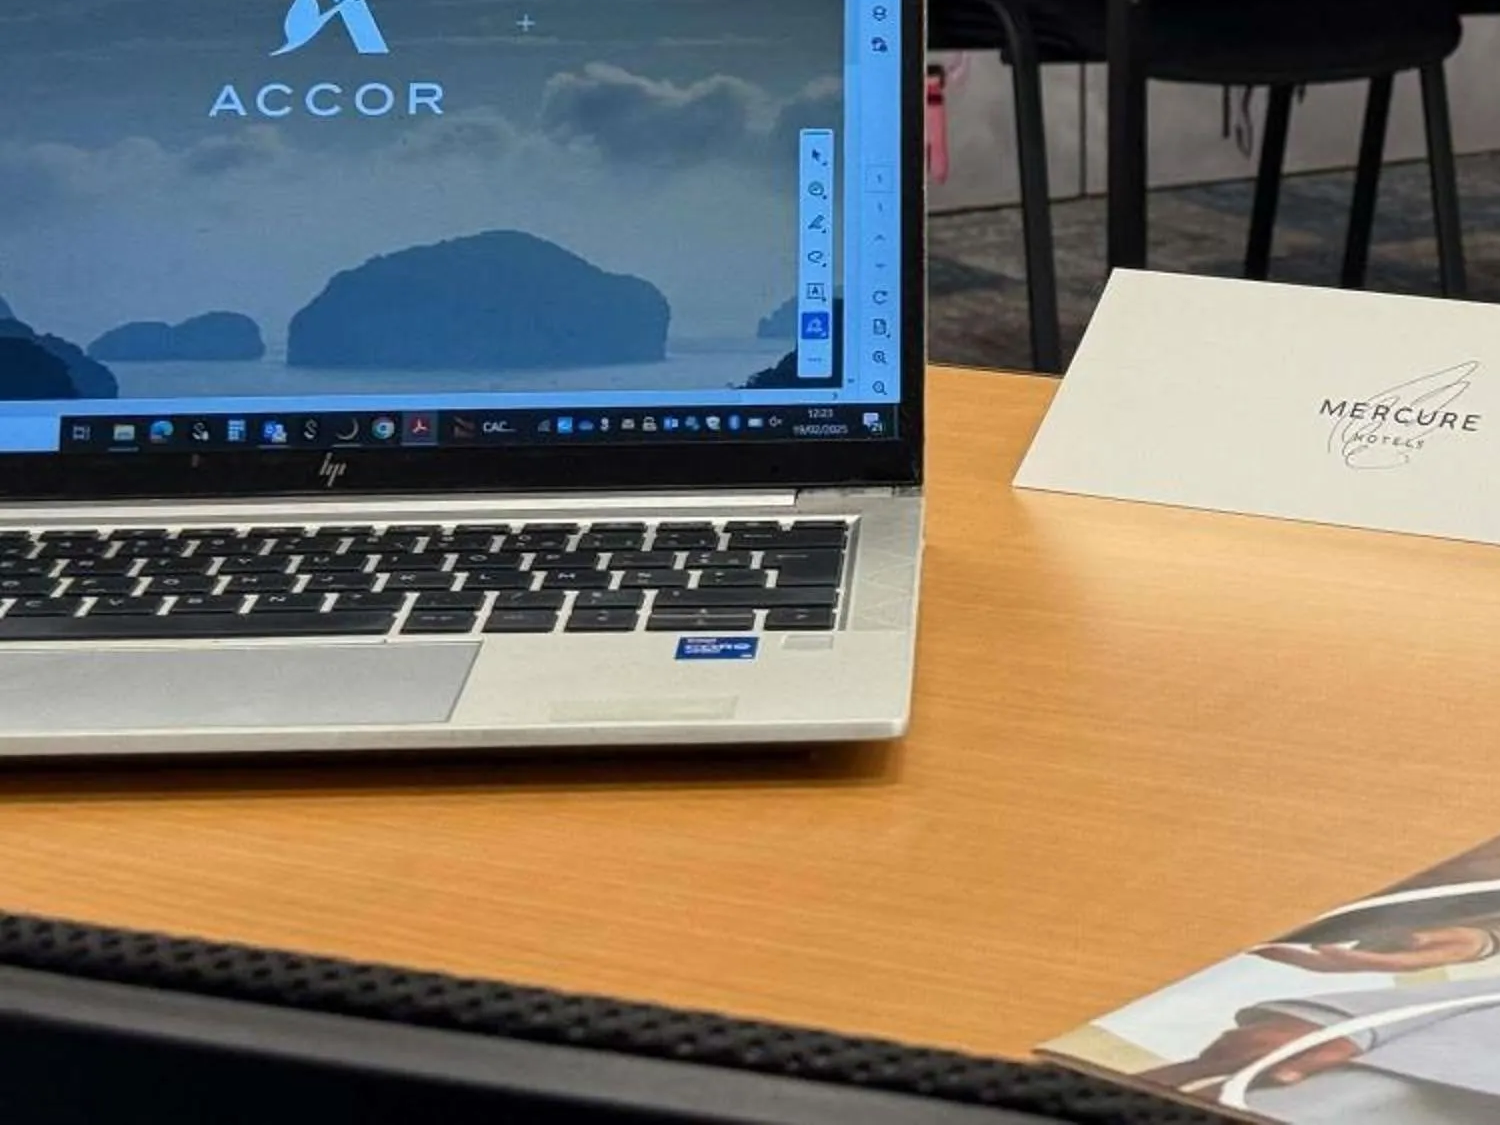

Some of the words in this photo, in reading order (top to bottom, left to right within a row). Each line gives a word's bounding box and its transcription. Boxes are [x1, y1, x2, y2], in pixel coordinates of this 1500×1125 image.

[208, 82, 444, 117] ACCOR
[1319, 398, 1482, 432] MERCURE
[1351, 432, 1425, 450] HOTELS
